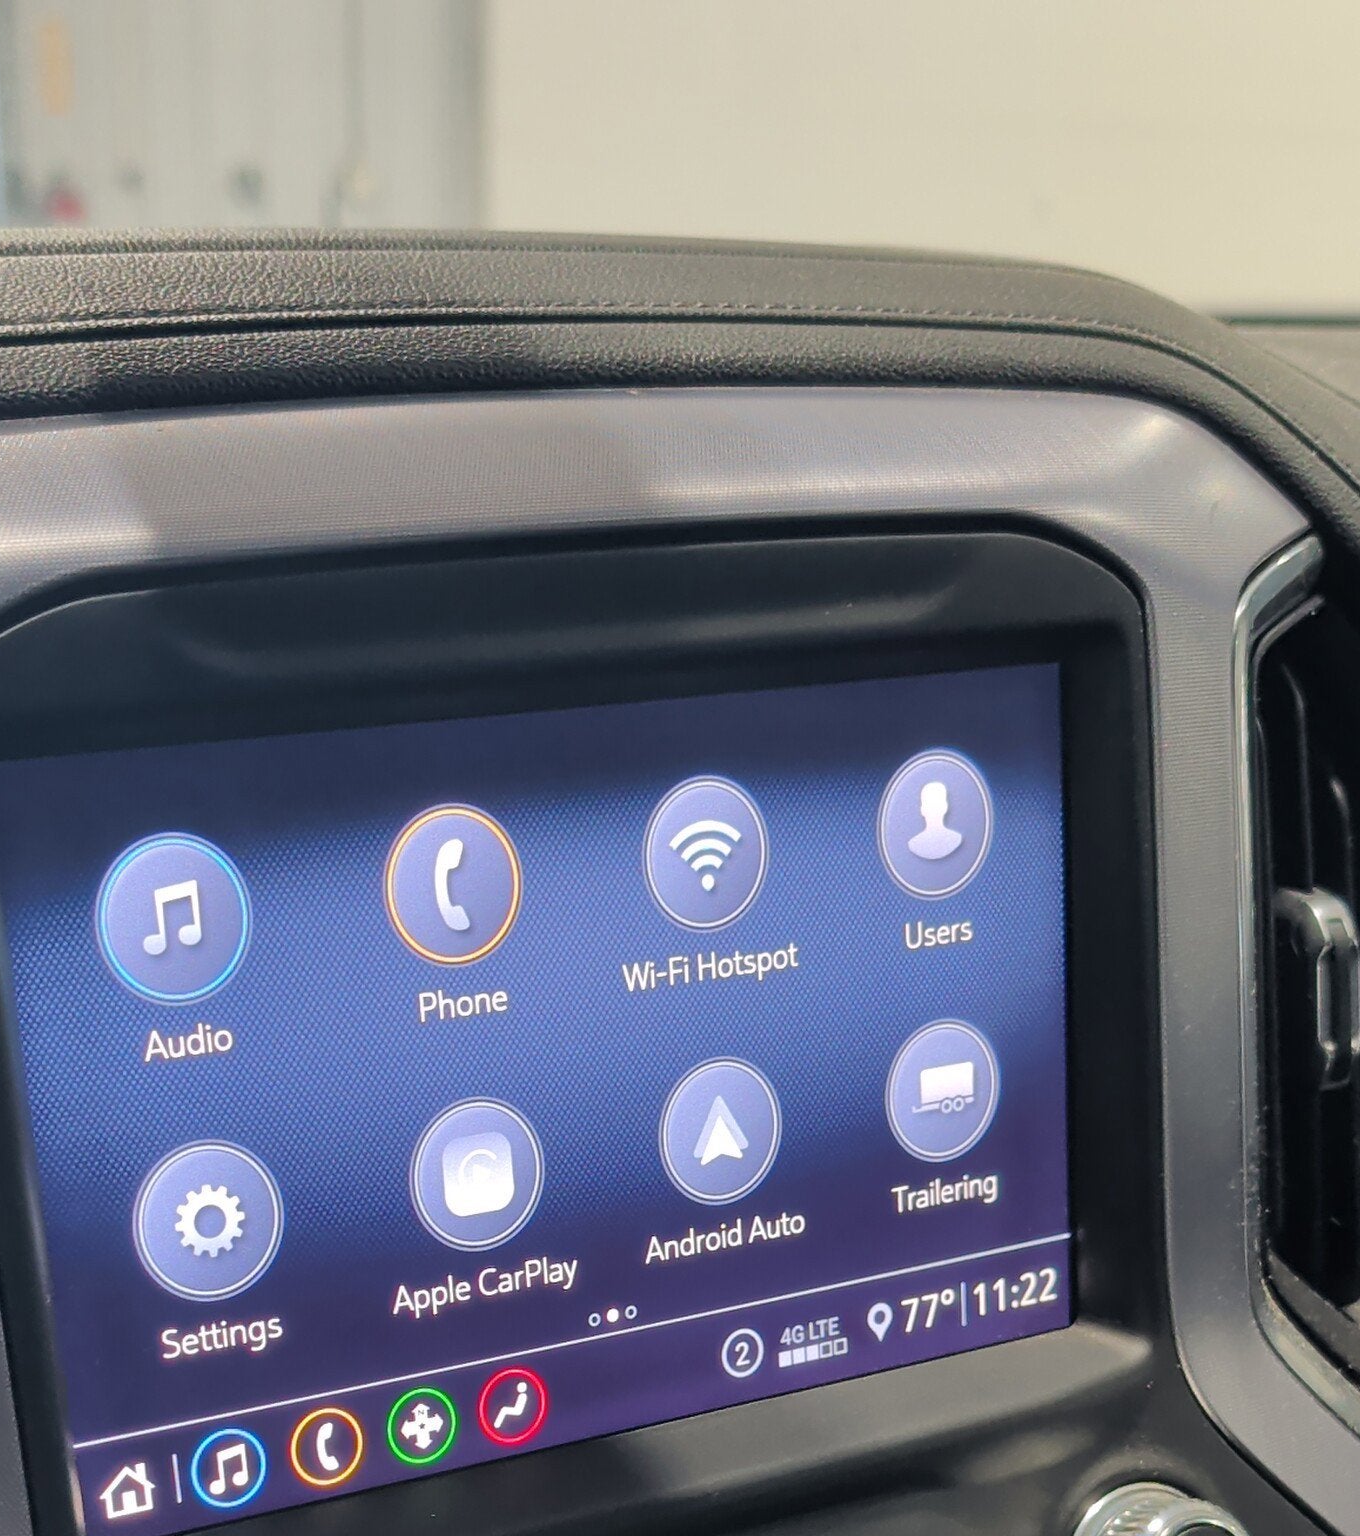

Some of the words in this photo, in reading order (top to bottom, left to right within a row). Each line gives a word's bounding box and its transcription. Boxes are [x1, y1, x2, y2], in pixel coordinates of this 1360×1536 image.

[904, 920, 973, 950] Users
[621, 955, 690, 992] Wi-Fi
[696, 942, 799, 981] Hotspot
[418, 988, 509, 1023] Phone
[144, 1023, 234, 1062] Audio
[891, 1173, 999, 1213] Trailering
[645, 1219, 742, 1264] Android
[748, 1211, 806, 1244] Auto
[392, 1274, 472, 1319] Apple
[478, 1256, 578, 1298] CarPlay
[973, 1267, 1058, 1317] 11:22
[161, 1316, 284, 1360] Settings
[780, 1324, 805, 1346] 4G
[808, 1316, 840, 1340] LTE
